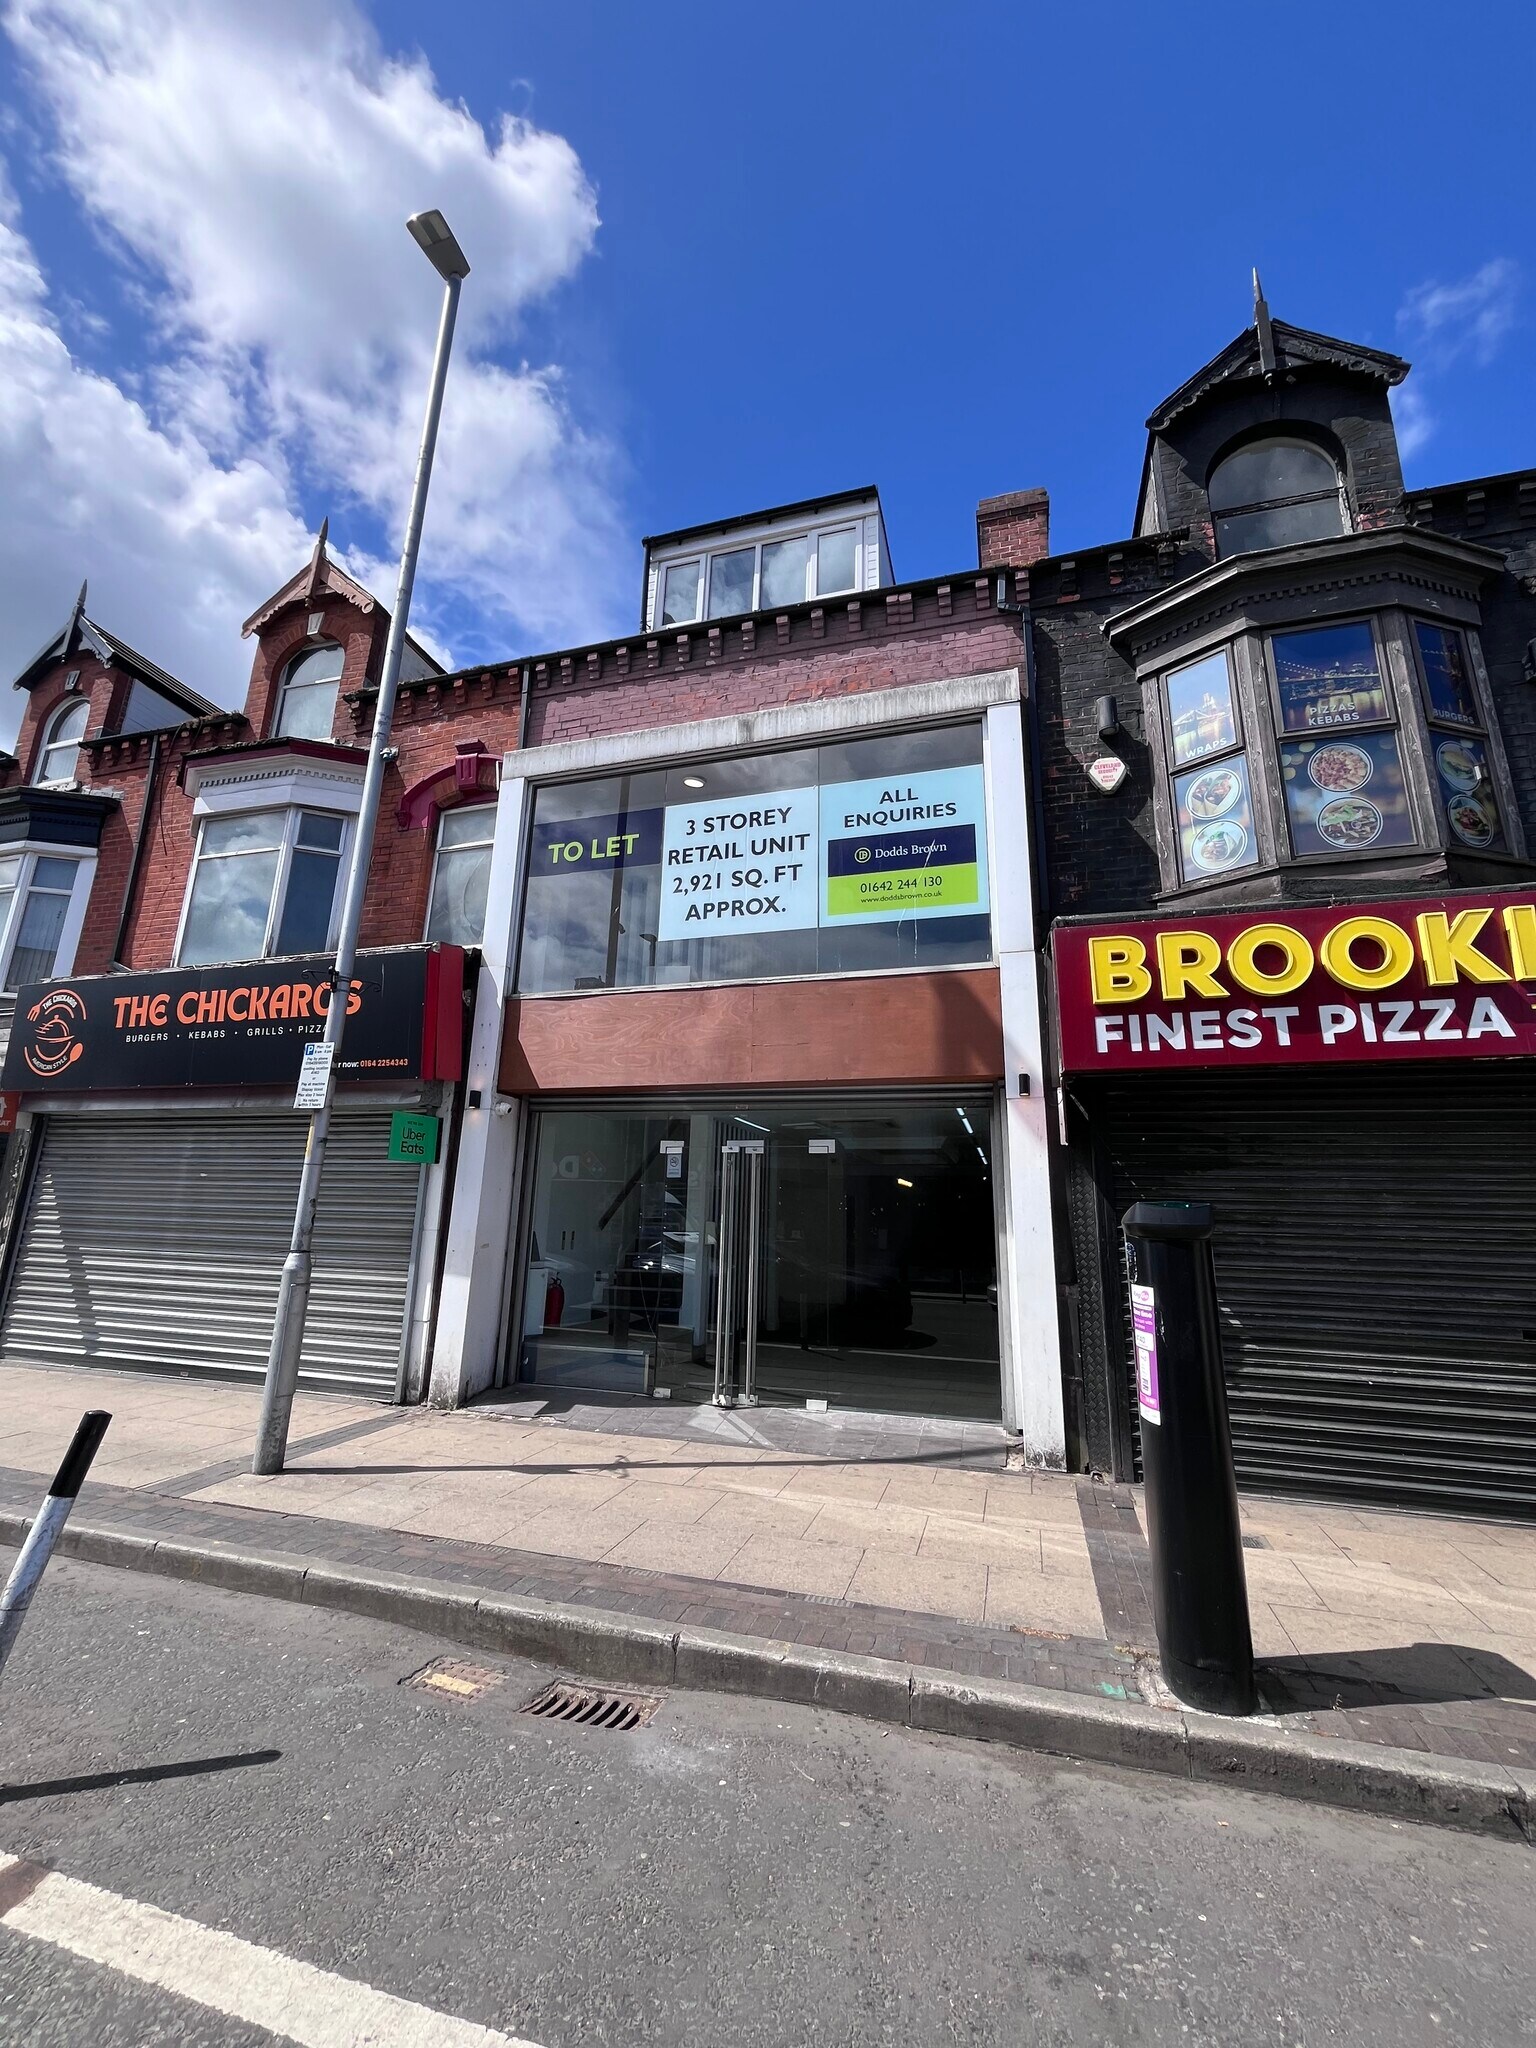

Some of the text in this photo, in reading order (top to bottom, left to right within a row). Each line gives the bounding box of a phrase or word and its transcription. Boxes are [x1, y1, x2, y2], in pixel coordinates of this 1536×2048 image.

[1309, 702, 1356, 715] PIZZAS
[1432, 708, 1475, 725] BURGERS
[1308, 712, 1360, 726] KEBABS
[1185, 737, 1227, 758] WRAPS
[879, 788, 918, 804] ALL
[686, 807, 792, 835] 3 STOREY
[844, 802, 957, 828] ENQUIRIES
[548, 833, 640, 864] TO LET
[668, 833, 810, 866] RETAIL UNIT
[874, 844, 947, 859] Dodds Brown
[673, 864, 803, 896] 2,921 SQ. FT
[860, 876, 942, 893] 01642 244 130
[860, 890, 942, 904] www.doddsbrown.co.uk
[685, 896, 786, 921] APPROX.
[42, 998, 53, 1010] THE
[113, 993, 170, 1028] THE
[1094, 996, 1517, 1053] FINEST PIZZA
[125, 1032, 169, 1043] BURGERS
[188, 1029, 226, 1040] KEBABS
[246, 1026, 284, 1037] GRILLS
[31, 1055, 68, 1070] AMERICAN STYLE
[377, 1058, 408, 1067] 2254343
[402, 1127, 426, 1141] Uber
[400, 1141, 425, 1155] Eats
